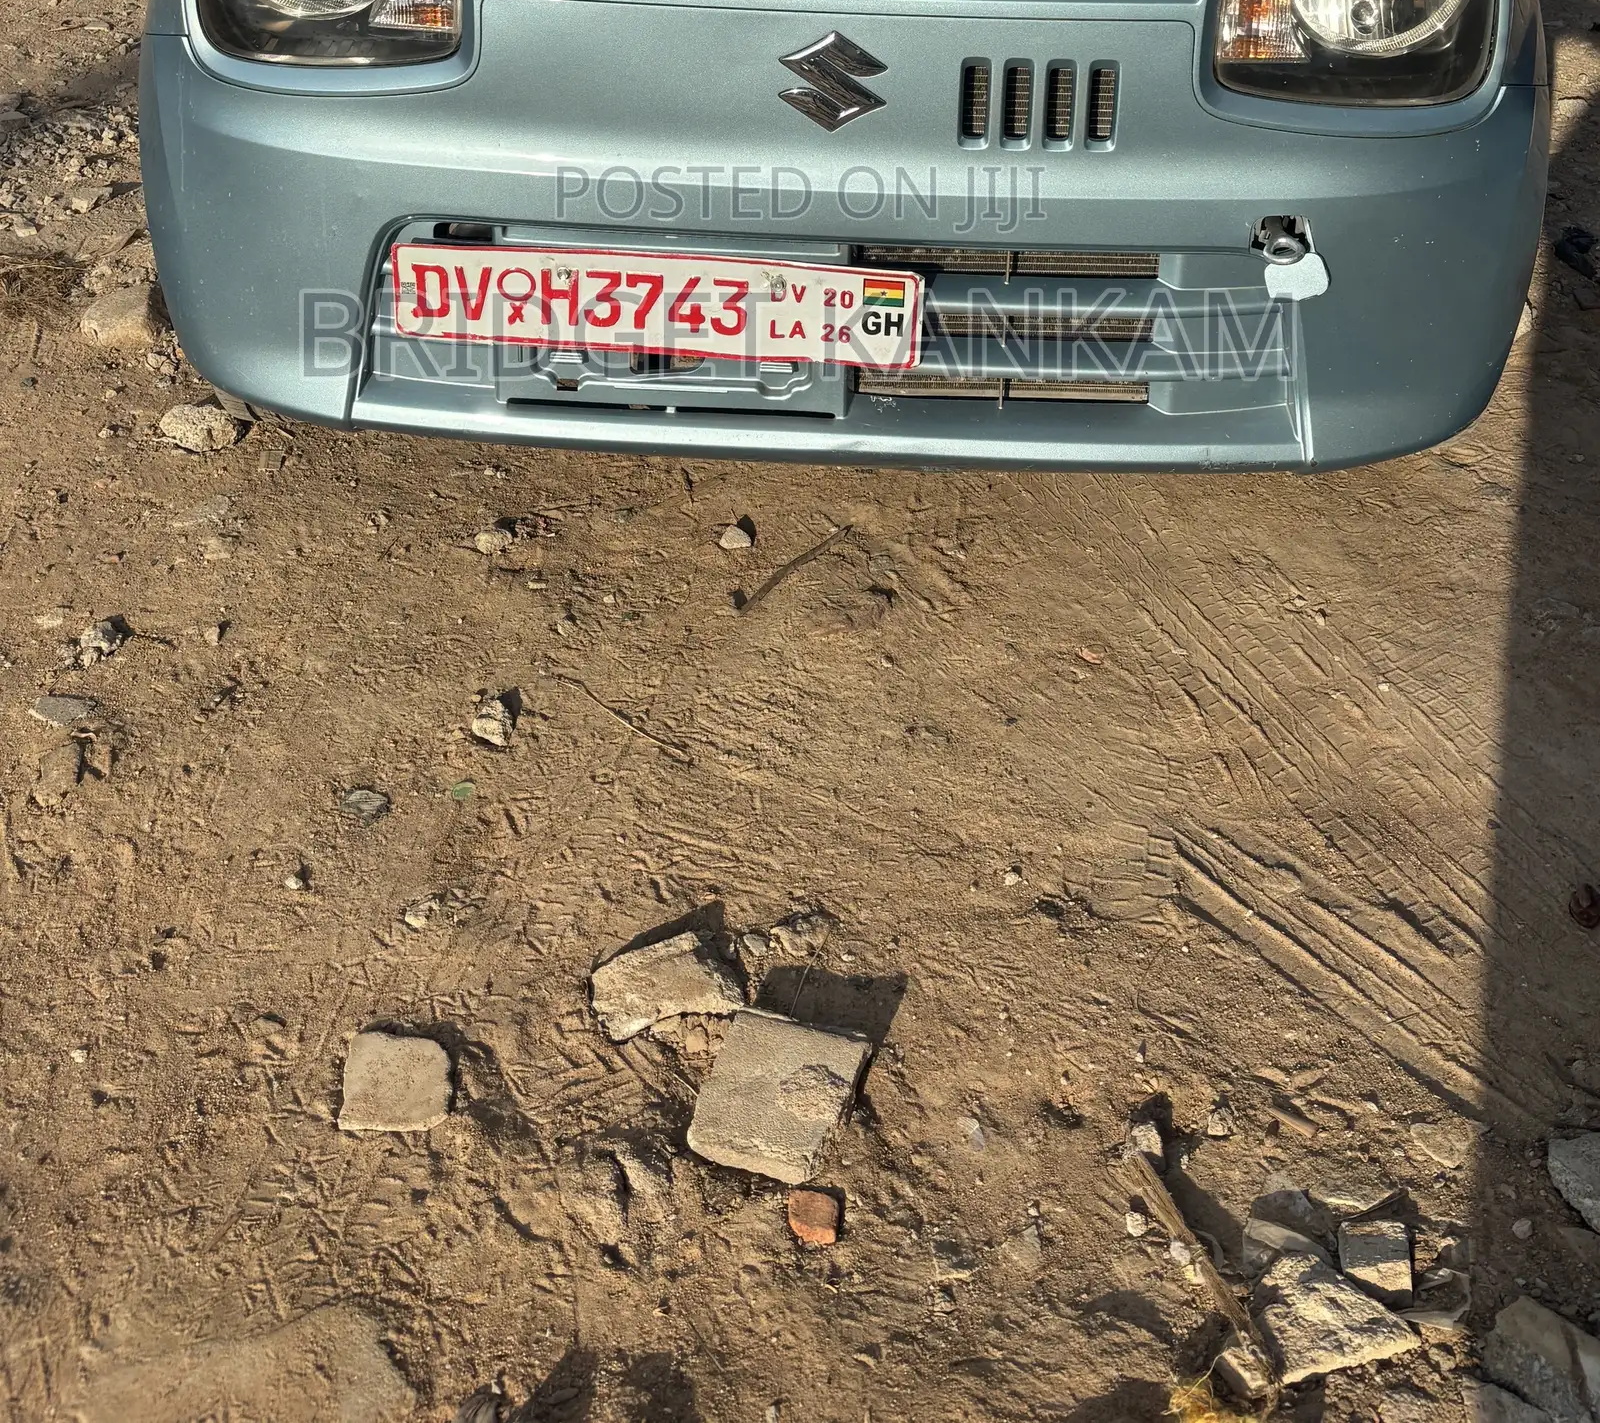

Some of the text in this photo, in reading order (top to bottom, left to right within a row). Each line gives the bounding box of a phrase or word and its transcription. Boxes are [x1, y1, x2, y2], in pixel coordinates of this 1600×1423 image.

[823, 287, 854, 309] 20
[769, 319, 851, 343] LA 26
[861, 311, 905, 337] GH
